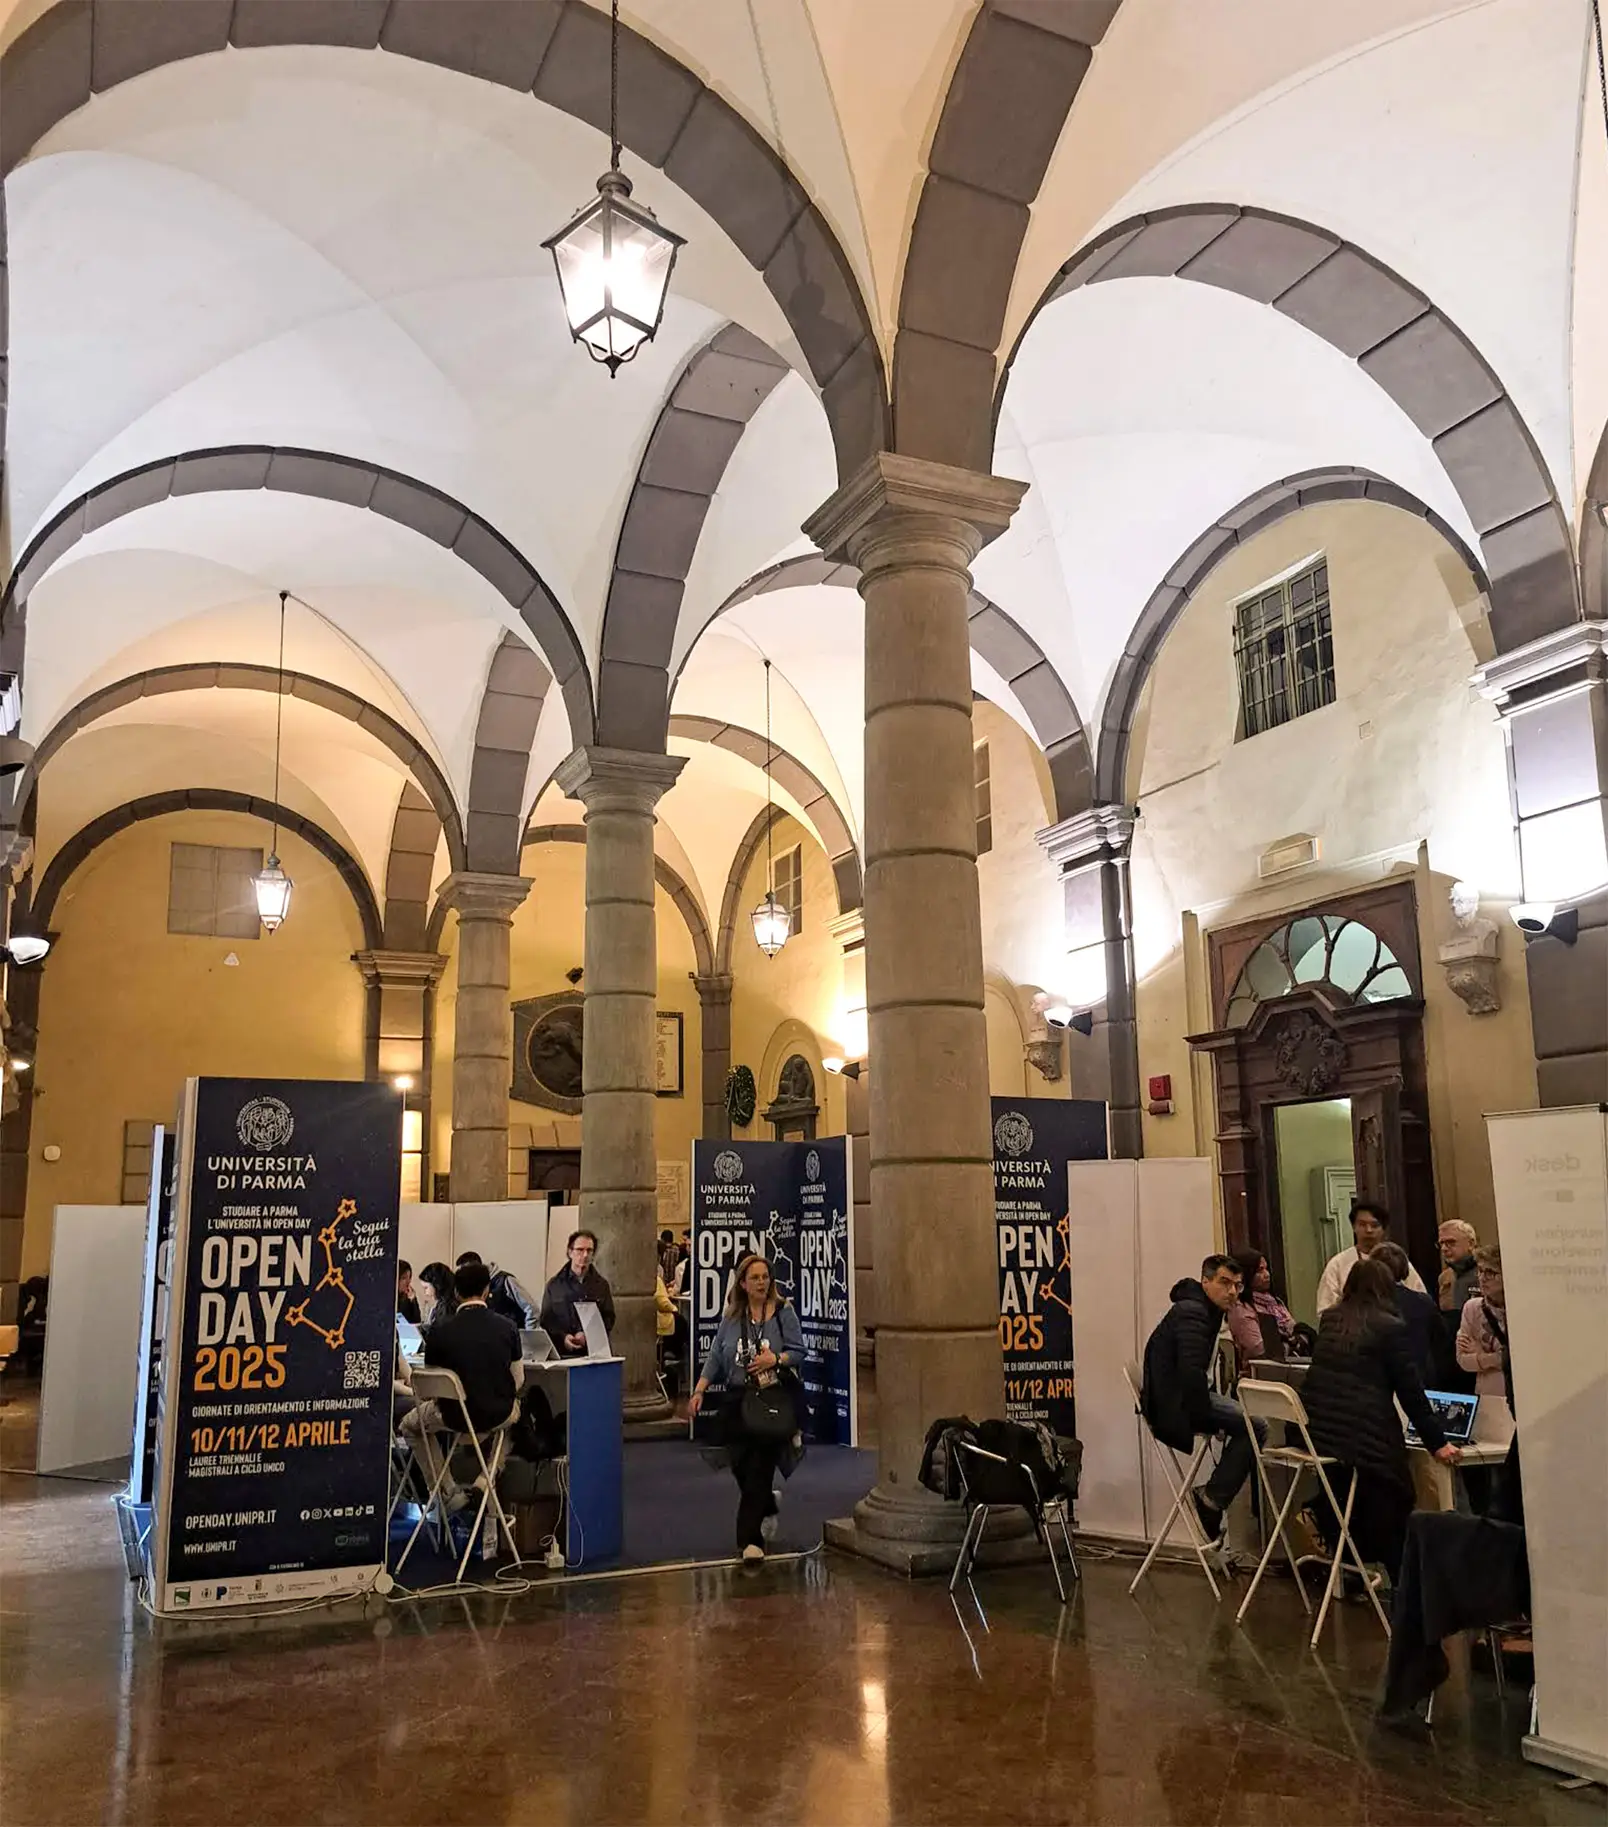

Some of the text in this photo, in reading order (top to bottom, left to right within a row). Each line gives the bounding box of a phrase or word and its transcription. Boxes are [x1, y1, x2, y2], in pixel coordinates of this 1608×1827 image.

[207, 1154, 317, 1172] UNIVERSITÀ
[217, 1175, 306, 1190] DI PARMA
[701, 1184, 756, 1195] UNIVERSITÀ
[800, 1182, 827, 1194] UNIVERSITÀ
[1002, 1176, 1046, 1189] PARMA
[705, 1195, 751, 1205] DI PARMA
[222, 1205, 299, 1217] STUDIARE A PARMA
[1040, 1211, 1051, 1220] DAY
[207, 1217, 312, 1230] L'UNIVERSITÀ IN OPEN DAY
[352, 1217, 390, 1237] Segui
[338, 1235, 381, 1250] la tua
[800, 1229, 832, 1267] OPEN
[1000, 1225, 1054, 1268] PEN
[201, 1235, 312, 1288] OPEN
[345, 1244, 386, 1263] stella
[801, 1268, 832, 1318] DAY
[1001, 1271, 1039, 1313] AY
[198, 1290, 287, 1345] DAY
[829, 1299, 848, 1320] 2025
[999, 1314, 1044, 1350] 025
[194, 1344, 288, 1391] 2025
[192, 1397, 370, 1418] GIORNATE DI ORIENTAMENTO E INFORMAZIONE
[191, 1419, 352, 1453] 10/11/12 APRILE
[188, 1461, 285, 1478] MAGISTRALI A CICLO UNICO
[189, 1453, 262, 1467] LAUREE TRIENNALI E
[185, 1509, 277, 1530] OPENDAY.UNIPR.IT
[184, 1540, 237, 1555] WWW.UNIPR.IT
